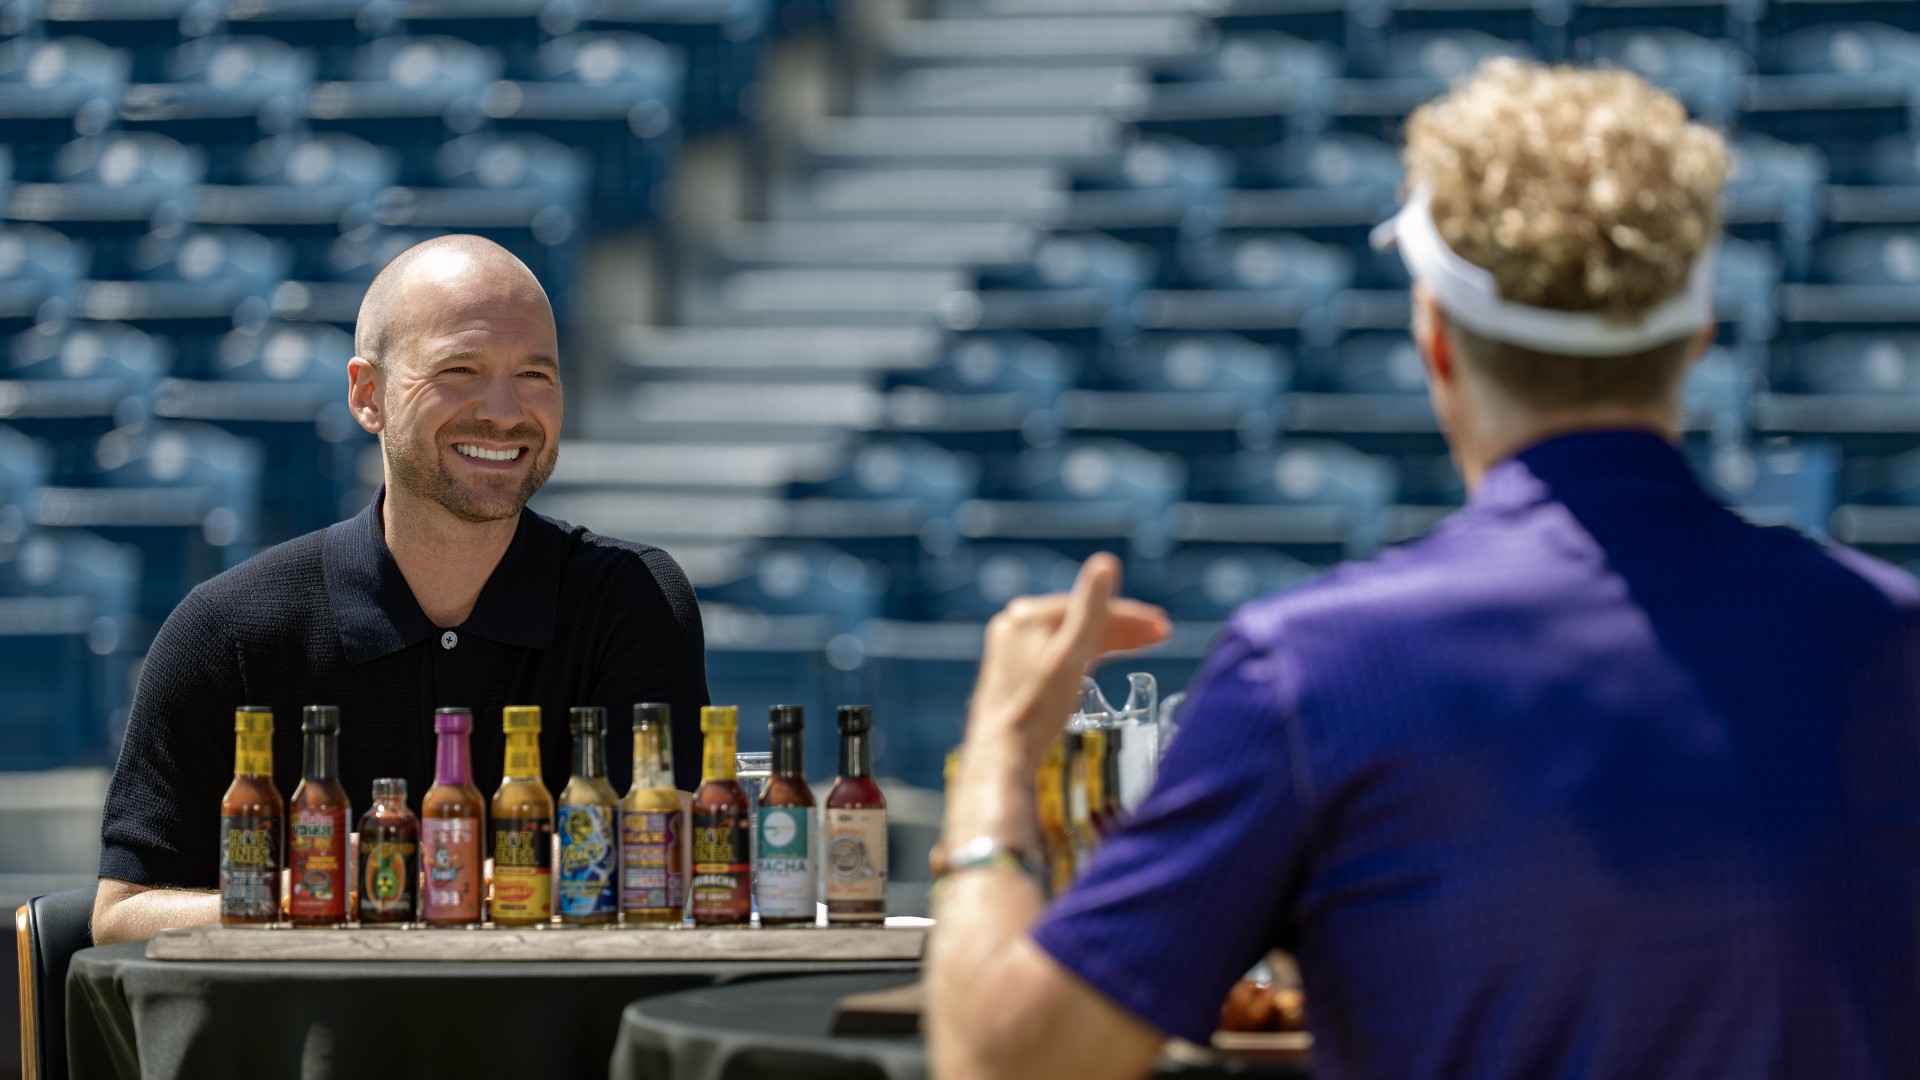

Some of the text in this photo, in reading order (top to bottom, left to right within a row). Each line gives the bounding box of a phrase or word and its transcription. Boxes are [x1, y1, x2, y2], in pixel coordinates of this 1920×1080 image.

[229, 829, 268, 846] HOT
[496, 831, 534, 848] HOT
[695, 827, 731, 845] HOT
[227, 846, 271, 863] ONES
[494, 847, 536, 863] ONES
[694, 844, 732, 862] ONES
